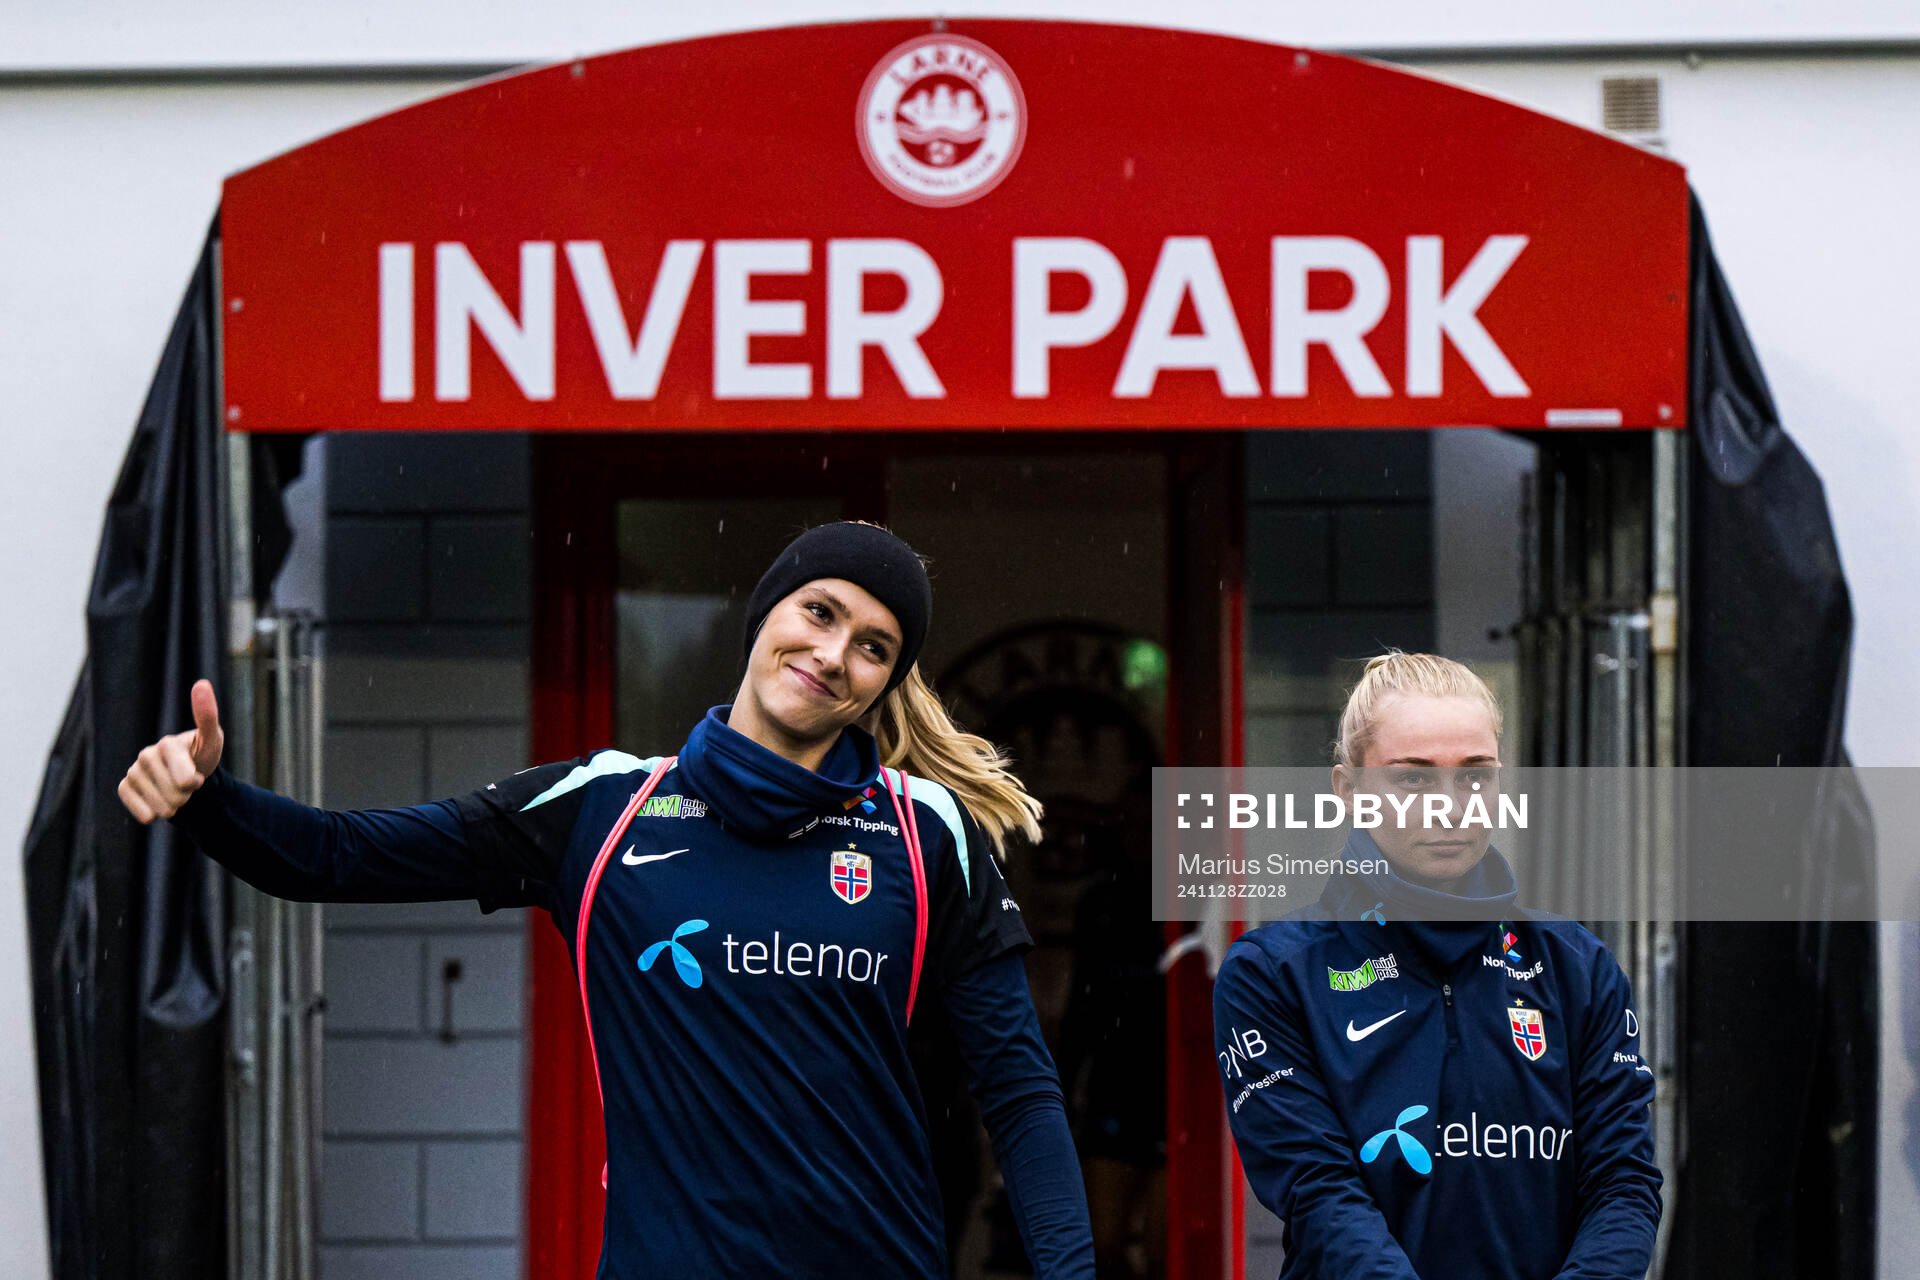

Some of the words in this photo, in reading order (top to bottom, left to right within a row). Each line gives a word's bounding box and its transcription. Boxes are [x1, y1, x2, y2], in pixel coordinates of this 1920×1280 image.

[379, 239, 945, 401] INVER
[1012, 235, 1529, 398] PARK
[821, 815, 852, 827] orsk
[852, 817, 899, 837] Tipping
[722, 931, 889, 985] telenor
[1328, 958, 1378, 991] KIWI
